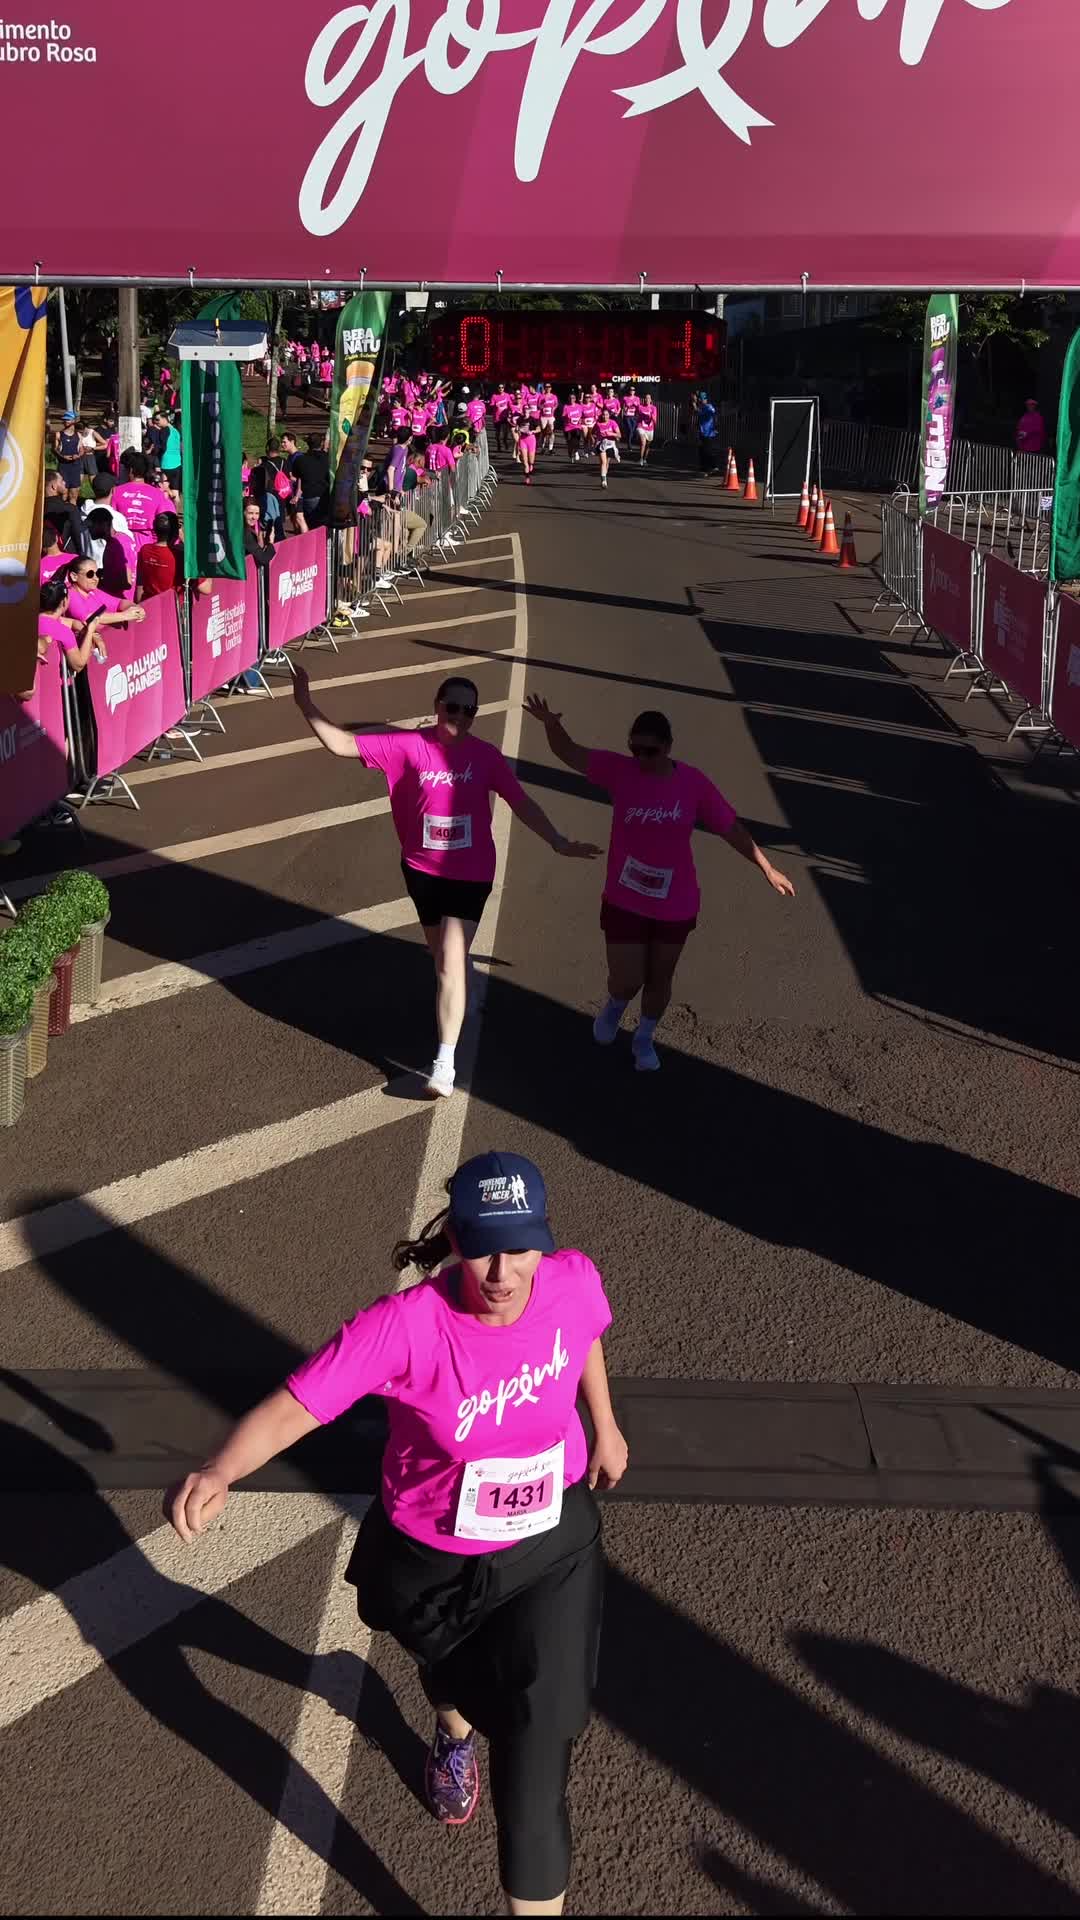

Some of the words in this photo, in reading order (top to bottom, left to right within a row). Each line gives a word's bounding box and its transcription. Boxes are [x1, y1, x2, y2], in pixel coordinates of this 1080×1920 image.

[46, 43, 97, 62] Rosa
[342, 327, 374, 343] BEBA
[343, 338, 381, 355] NATU
[460, 316, 490, 372] 0
[291, 564, 318, 585] PALHANO
[126, 644, 168, 682] PALHANO
[454, 1327, 569, 1443] gopink
[488, 1480, 545, 1509] 1431
